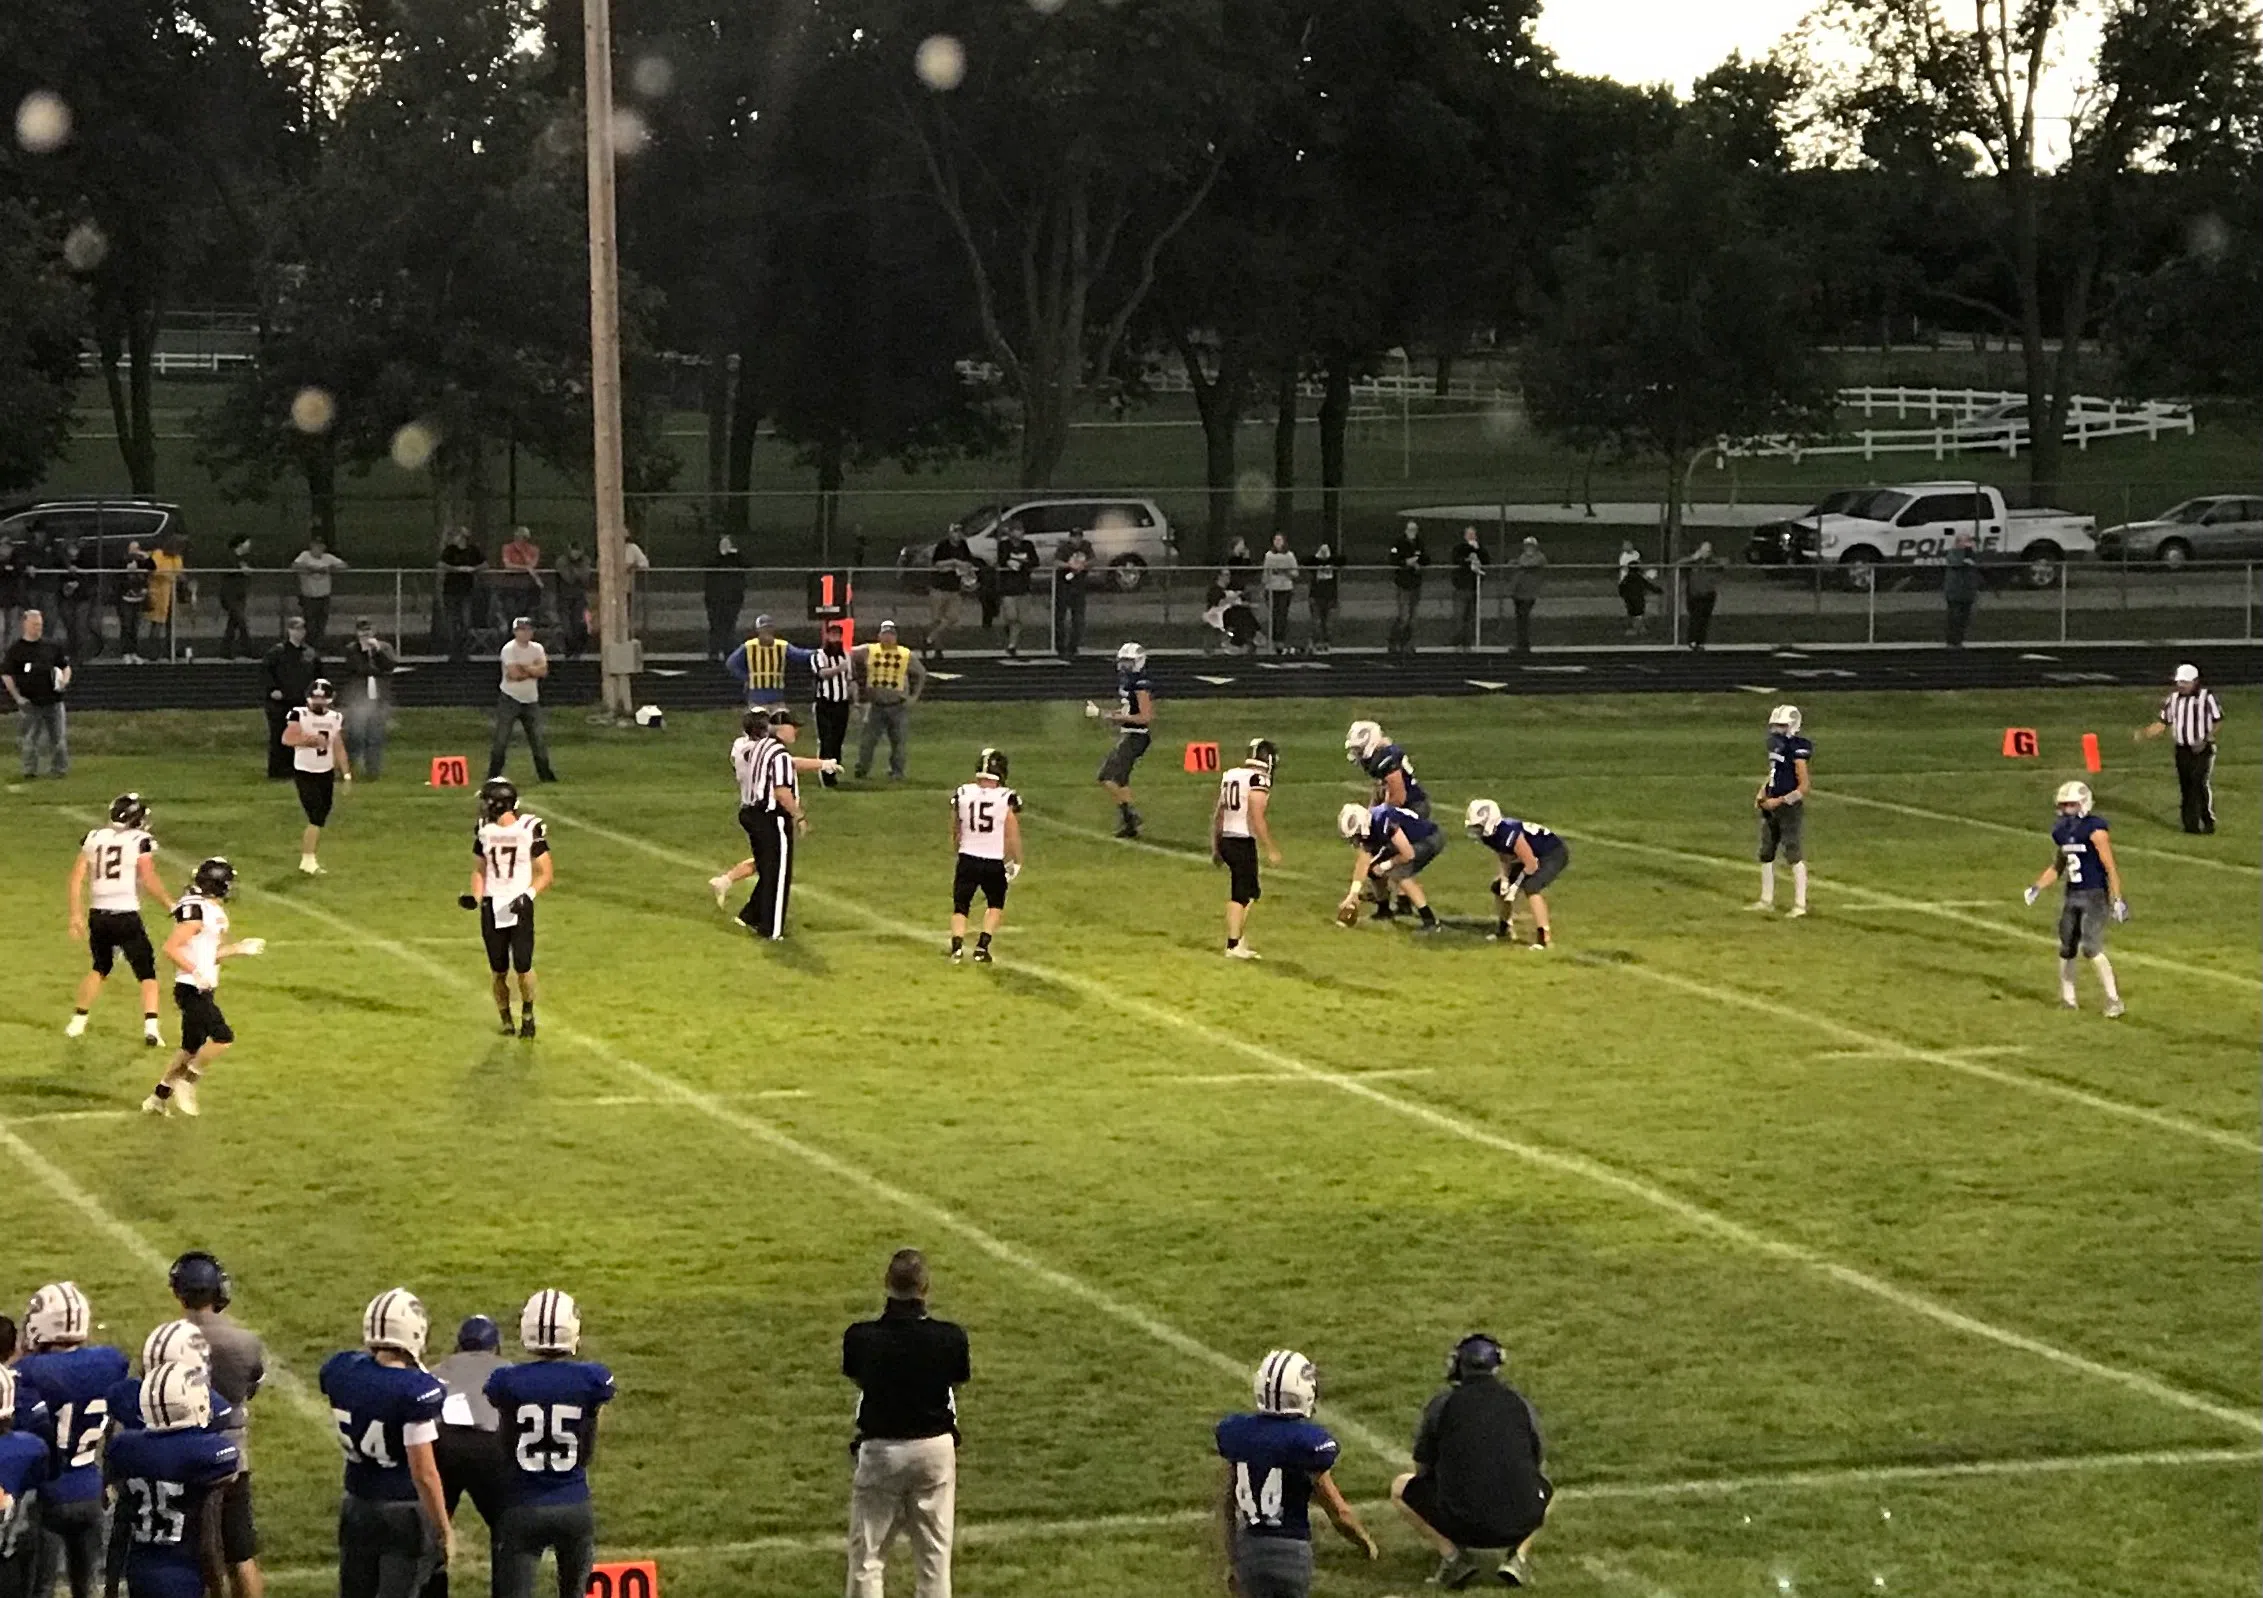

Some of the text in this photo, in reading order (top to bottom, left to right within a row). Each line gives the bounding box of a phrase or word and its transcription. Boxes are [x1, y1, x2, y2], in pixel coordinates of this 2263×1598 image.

[1896, 537, 2000, 557] POLE
[821, 575, 834, 608] 1
[1192, 747, 1217, 770] 10
[2014, 731, 2034, 755] G
[437, 760, 464, 785] 20
[968, 801, 994, 833] 15
[94, 844, 122, 880] 12
[489, 846, 518, 879] 17
[2067, 853, 2083, 884] 2
[54, 1398, 110, 1468] 12
[516, 1403, 583, 1472] 25
[126, 1476, 186, 1545] 35
[1235, 1461, 1283, 1527] 44
